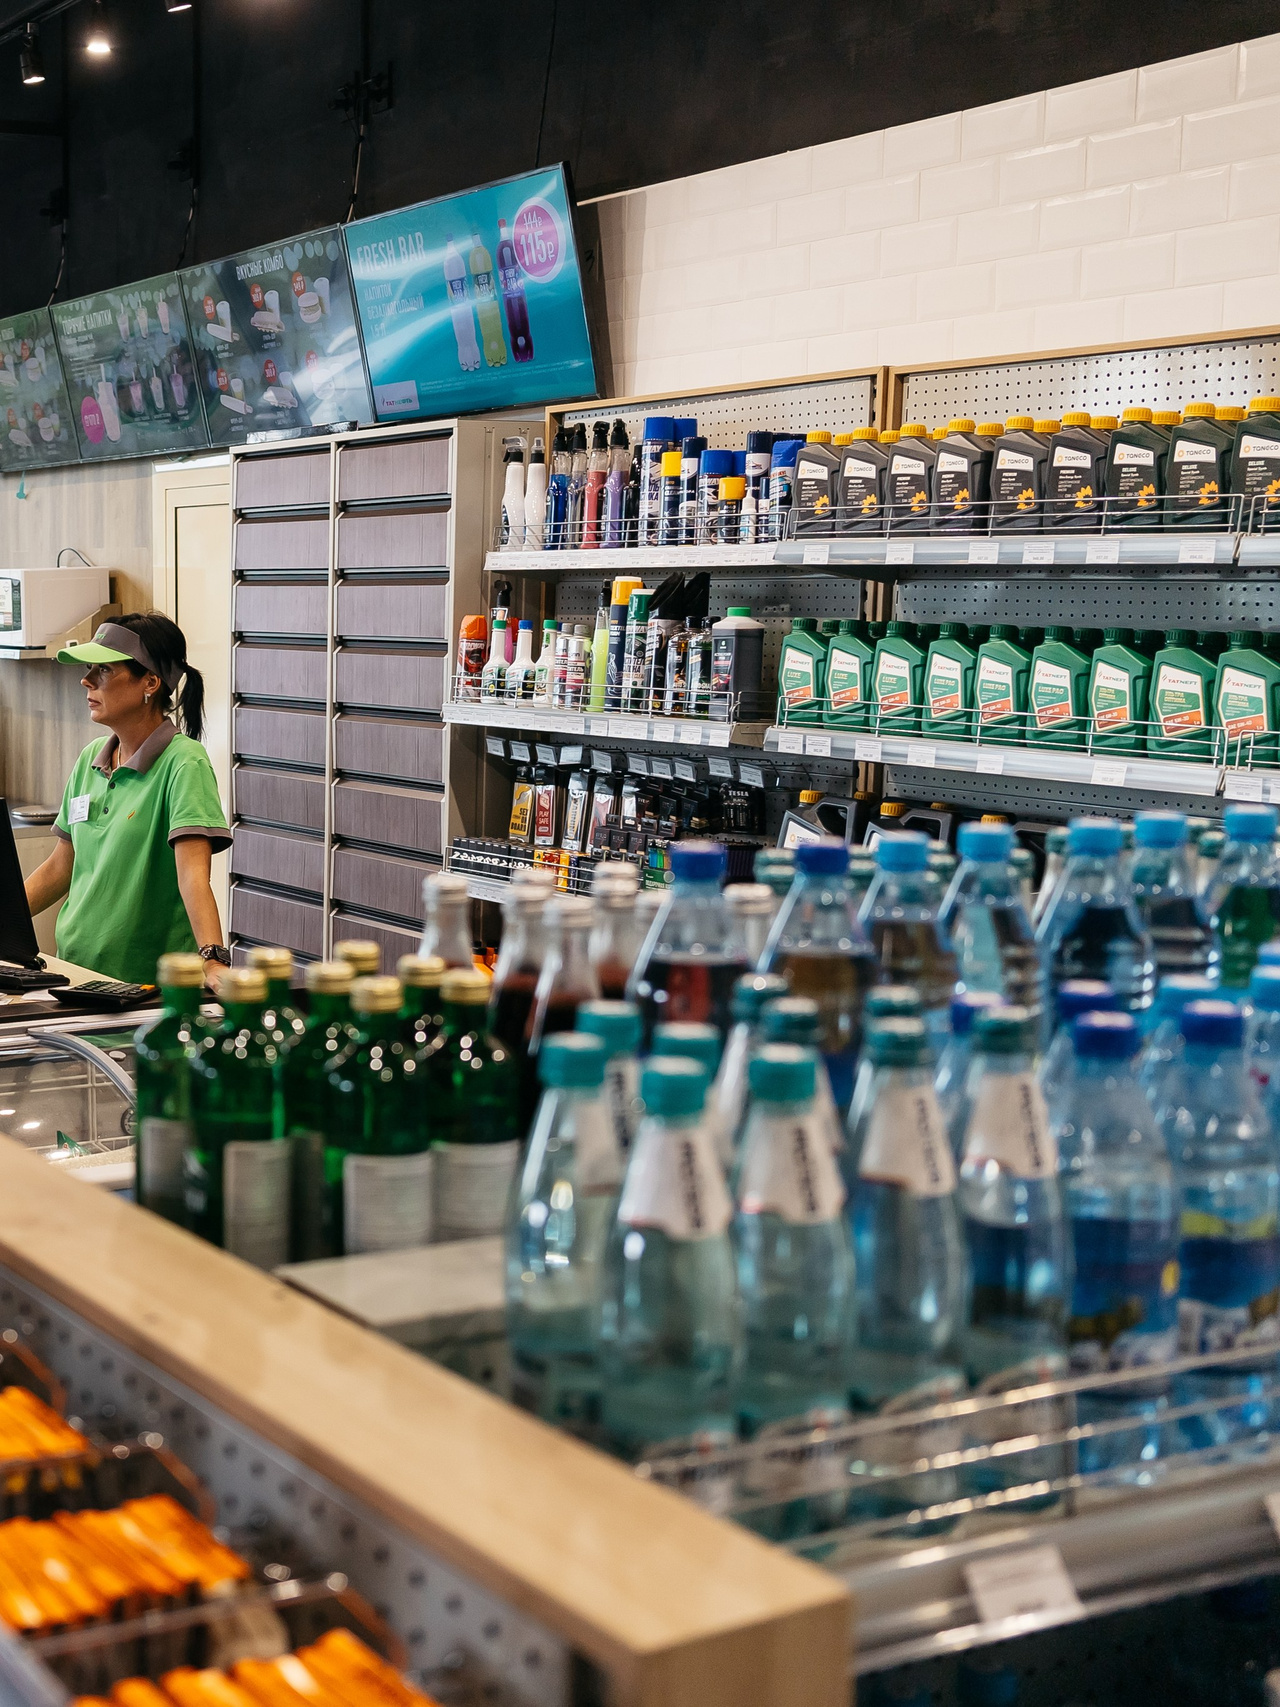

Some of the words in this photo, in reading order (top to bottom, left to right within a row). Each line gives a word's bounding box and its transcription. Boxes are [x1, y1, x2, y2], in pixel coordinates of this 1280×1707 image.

[356, 237, 395, 274] FRESH
[398, 232, 426, 265] BAR
[236, 259, 262, 281] ВКУСНЫЕ
[263, 254, 284, 275] КОМБО
[364, 282, 392, 301] НАПИТОК
[510, 822, 526, 832] BOARD
